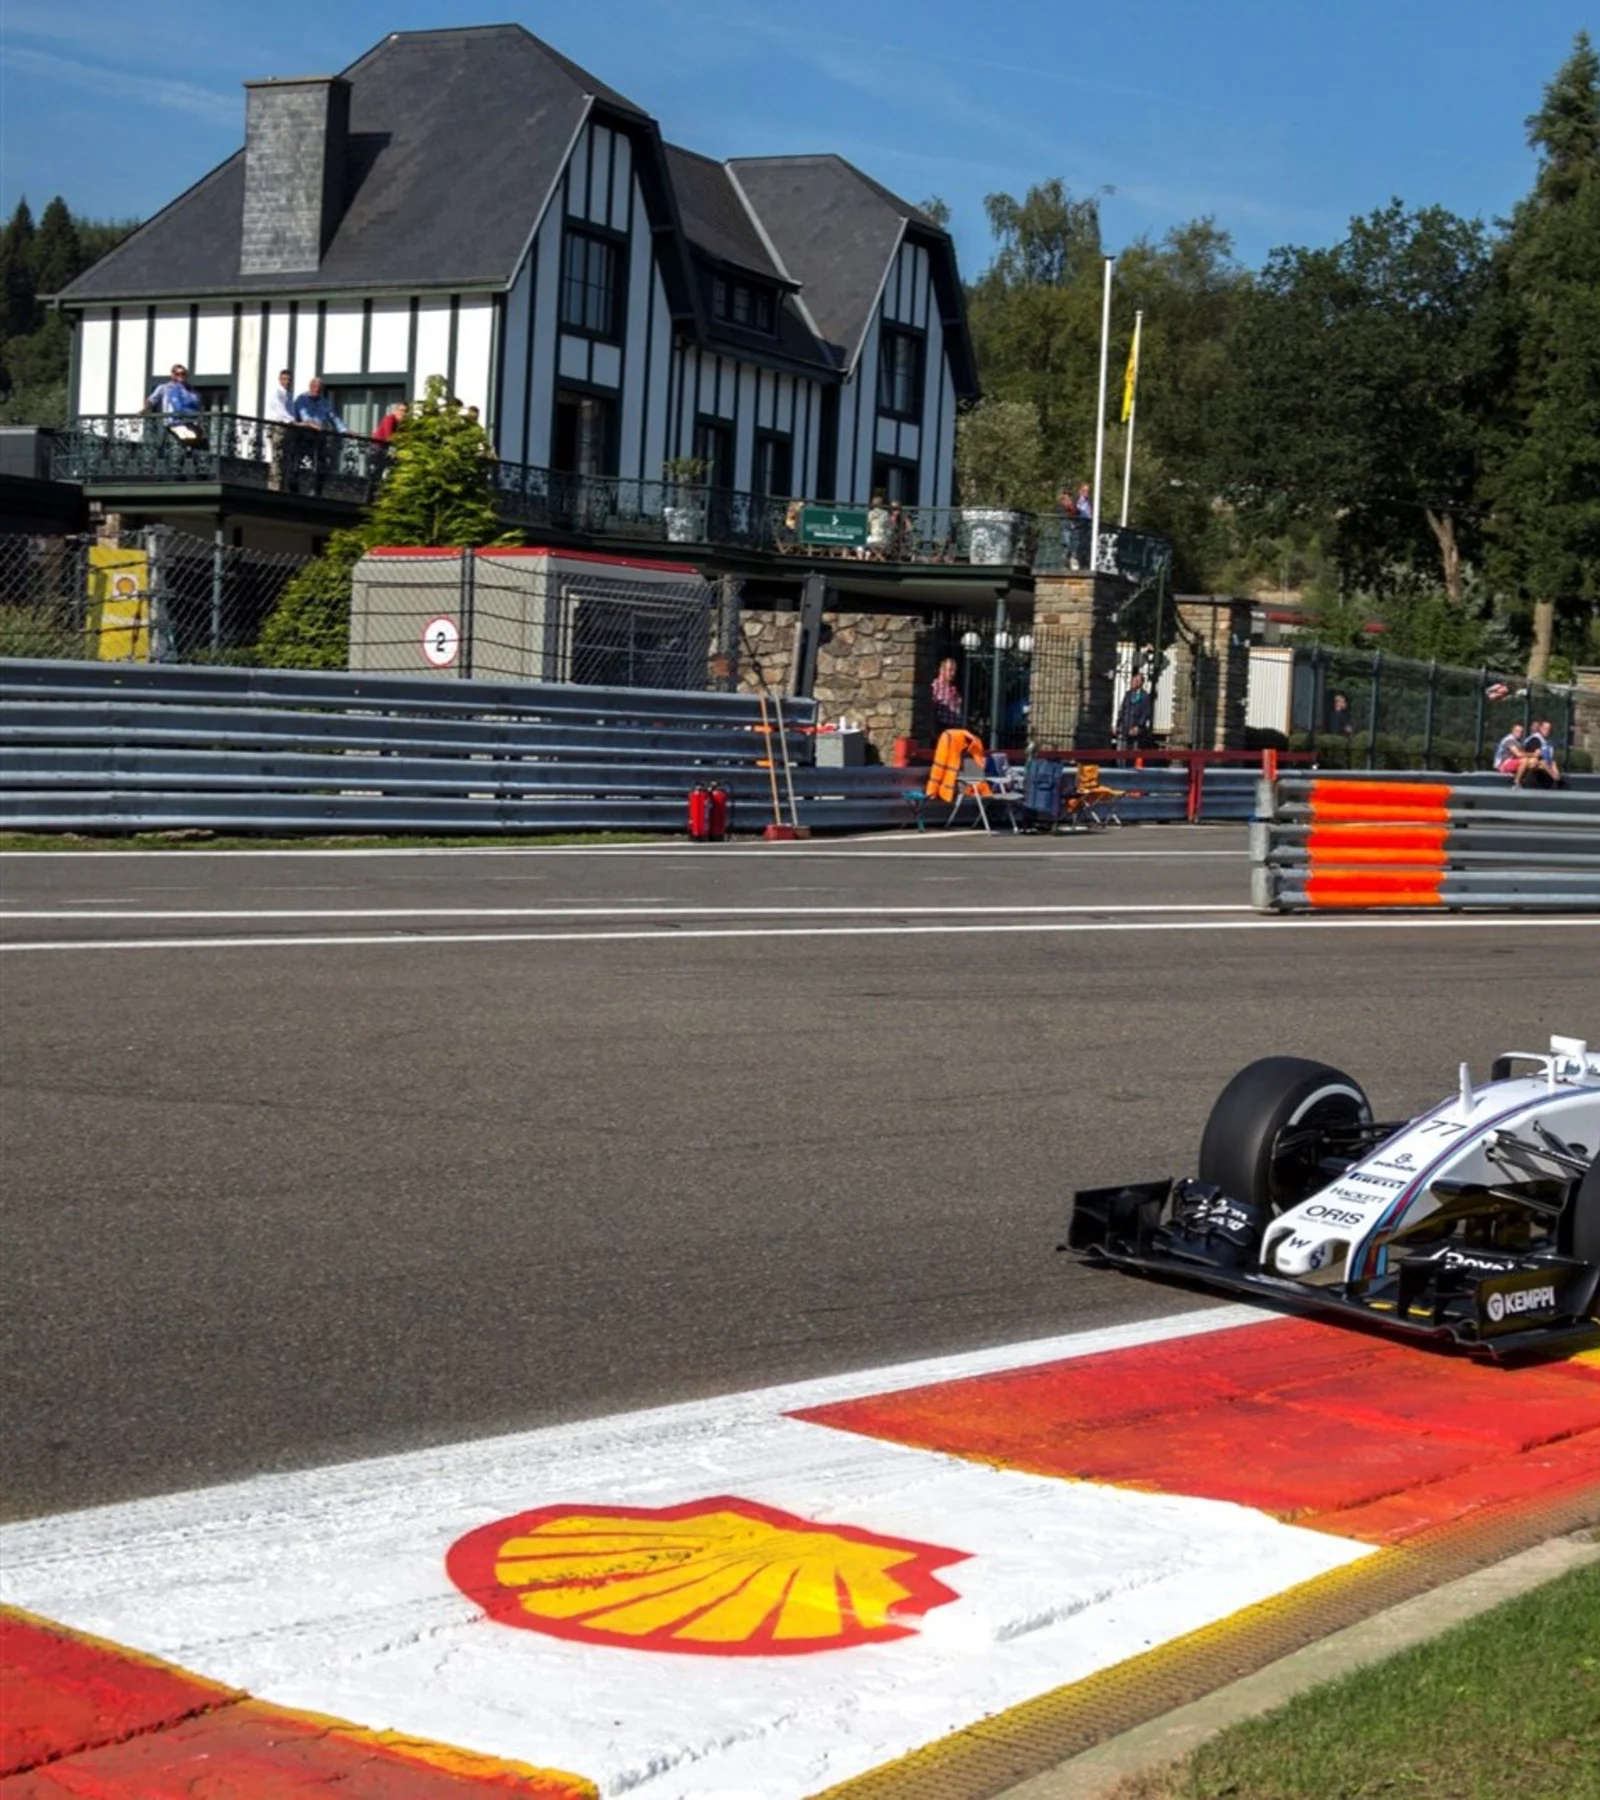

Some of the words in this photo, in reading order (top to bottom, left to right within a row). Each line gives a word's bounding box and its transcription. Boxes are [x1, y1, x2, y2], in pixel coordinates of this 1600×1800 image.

[435, 631, 446, 652] 2
[1420, 1119, 1468, 1137] 77
[1348, 1172, 1407, 1190] PIRELLI
[1306, 1205, 1365, 1225] ORIS
[1506, 1286, 1556, 1315] KEMPPI
